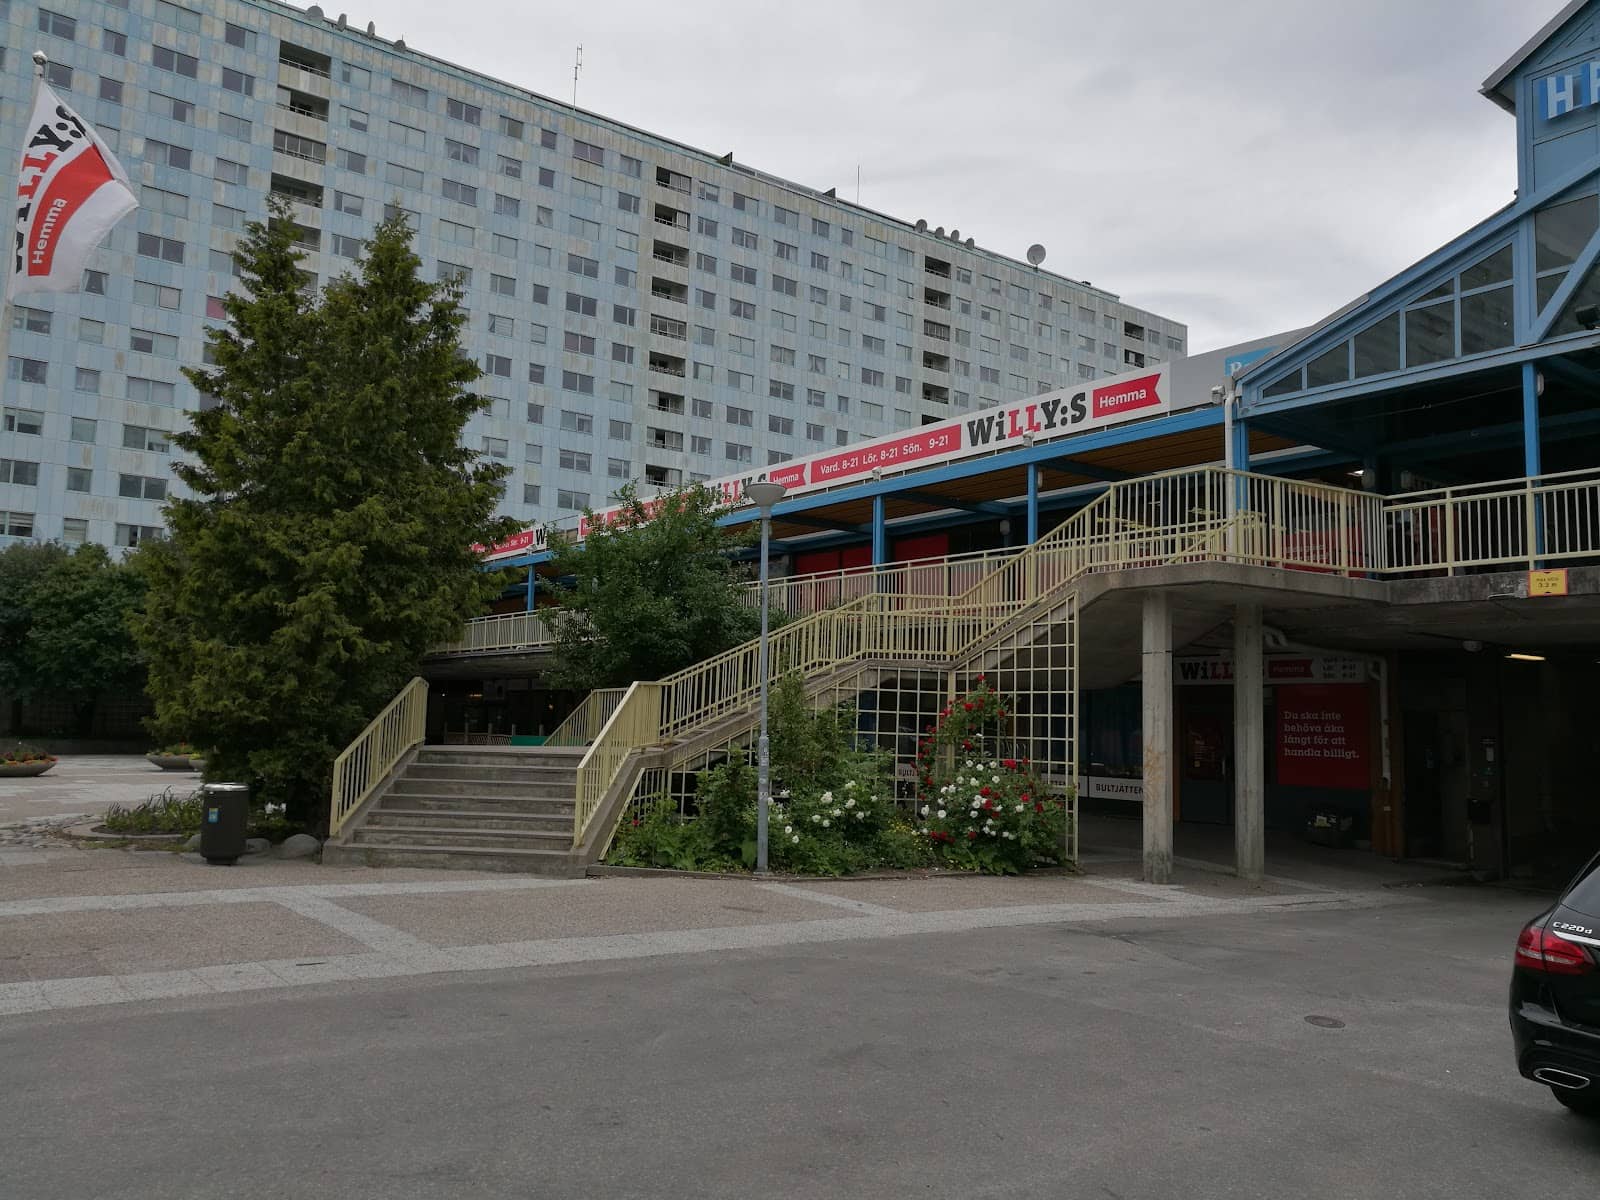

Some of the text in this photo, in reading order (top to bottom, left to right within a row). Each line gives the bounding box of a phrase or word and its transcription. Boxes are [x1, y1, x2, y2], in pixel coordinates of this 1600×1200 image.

[32, 198, 68, 265] Hemma
[1099, 388, 1147, 408] Hemma
[820, 435, 948, 475] Vard. 8-21 Lör. 8-21 Sön. 9-21
[1283, 710, 1342, 720] Du ska inte
[1284, 723, 1345, 733] behöva åka
[1284, 735, 1346, 746] långt för att
[1284, 747, 1360, 760] handla billigt.
